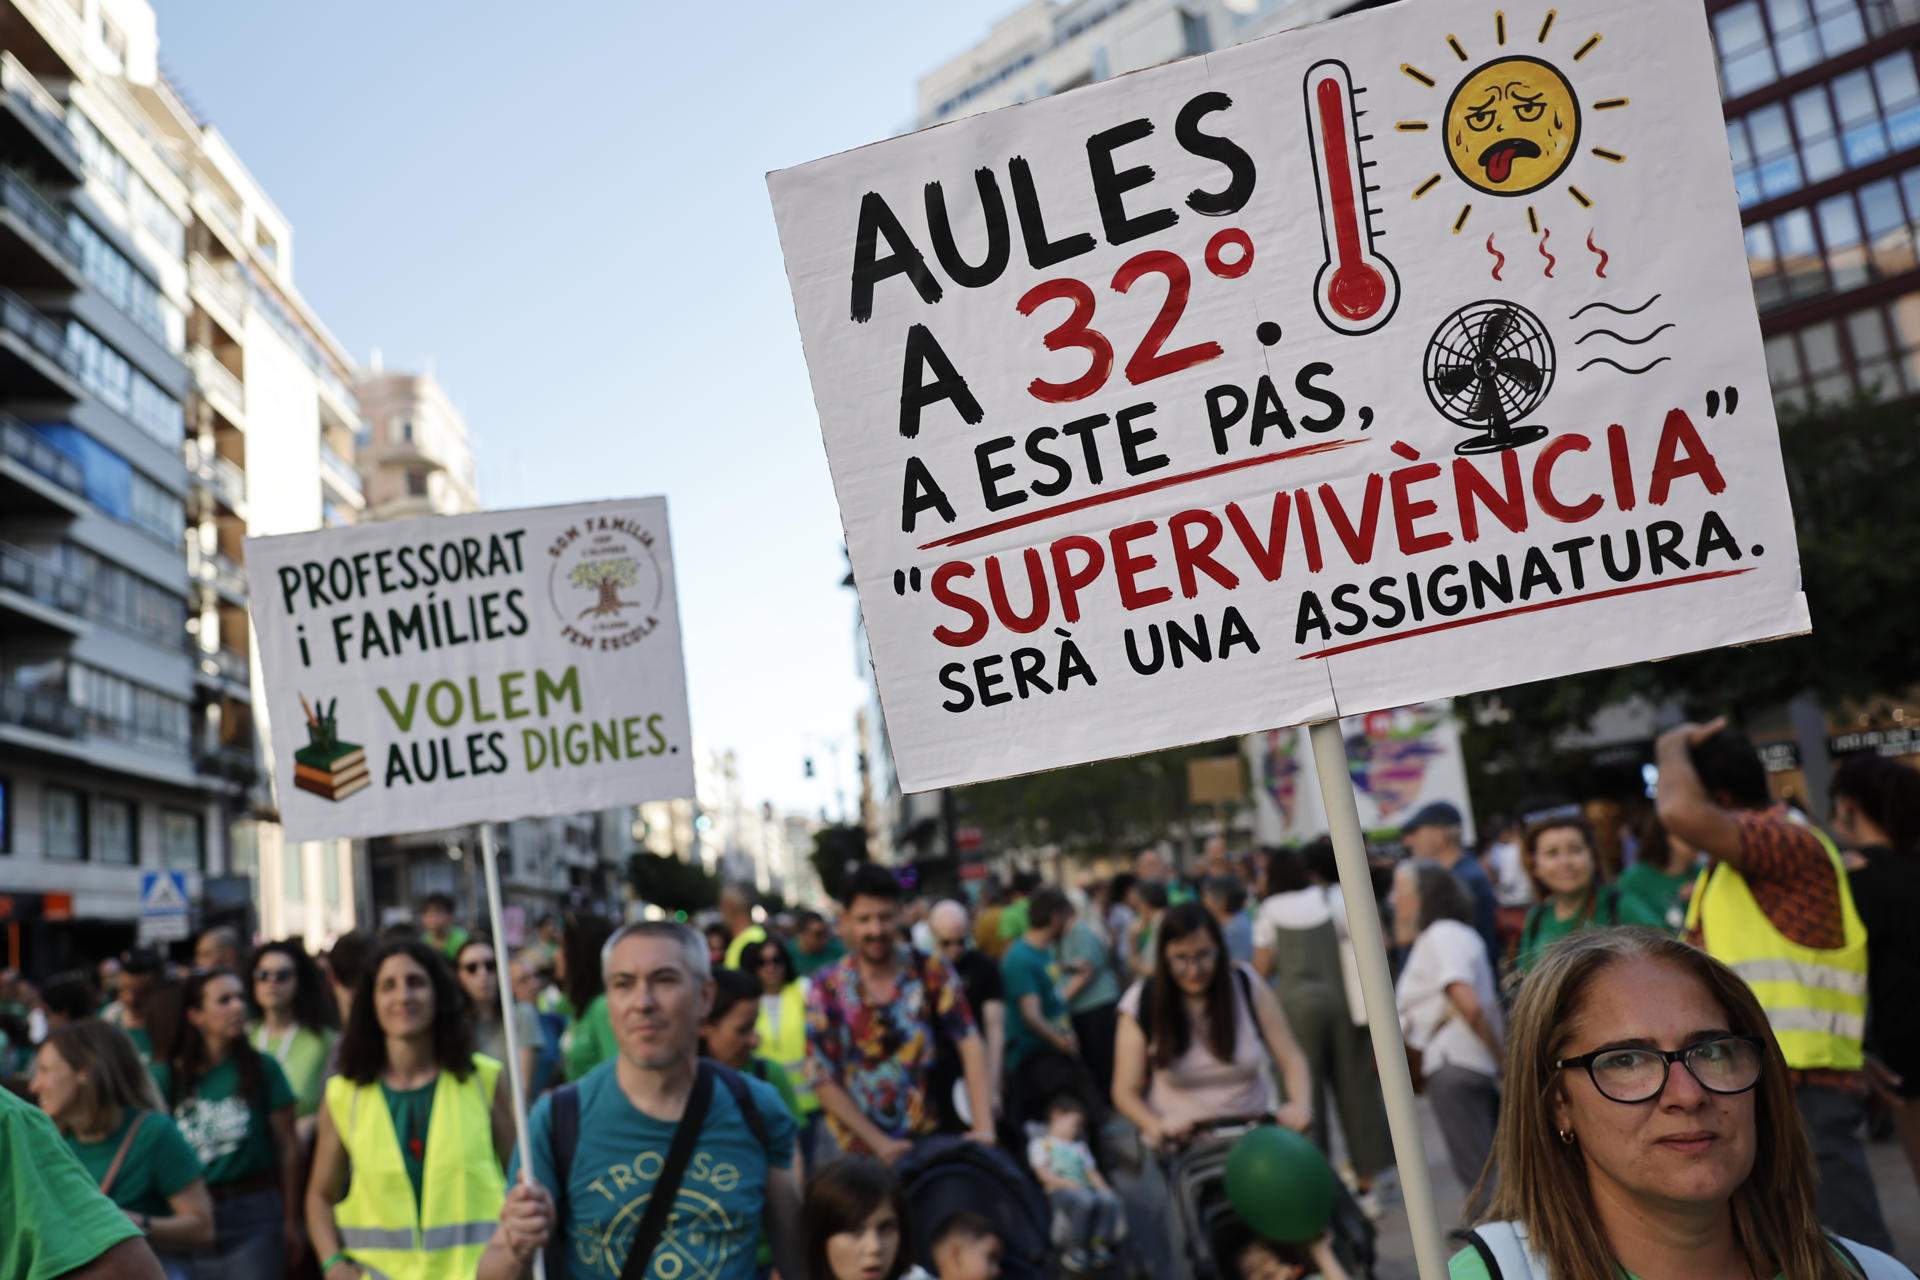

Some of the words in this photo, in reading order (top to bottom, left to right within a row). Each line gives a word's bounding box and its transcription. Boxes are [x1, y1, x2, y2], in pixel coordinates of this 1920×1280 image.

[851, 91, 1257, 323] AULES
[900, 323, 985, 439] A
[902, 456, 957, 533] A
[974, 402, 1171, 512] ESTE
[1205, 362, 1374, 455] PAS,
[278, 529, 527, 614] PROFESSORAT
[939, 627, 1098, 713] SERÀ
[1124, 606, 1261, 676] UNA
[1295, 511, 1765, 644] ASSIGNATURA.
[331, 588, 530, 664] FAMÍLIES
[376, 665, 583, 733] VOLEM
[385, 731, 509, 788] AULES
[521, 713, 679, 773] DIGNES.
[587, 1151, 741, 1201] TROSØ
